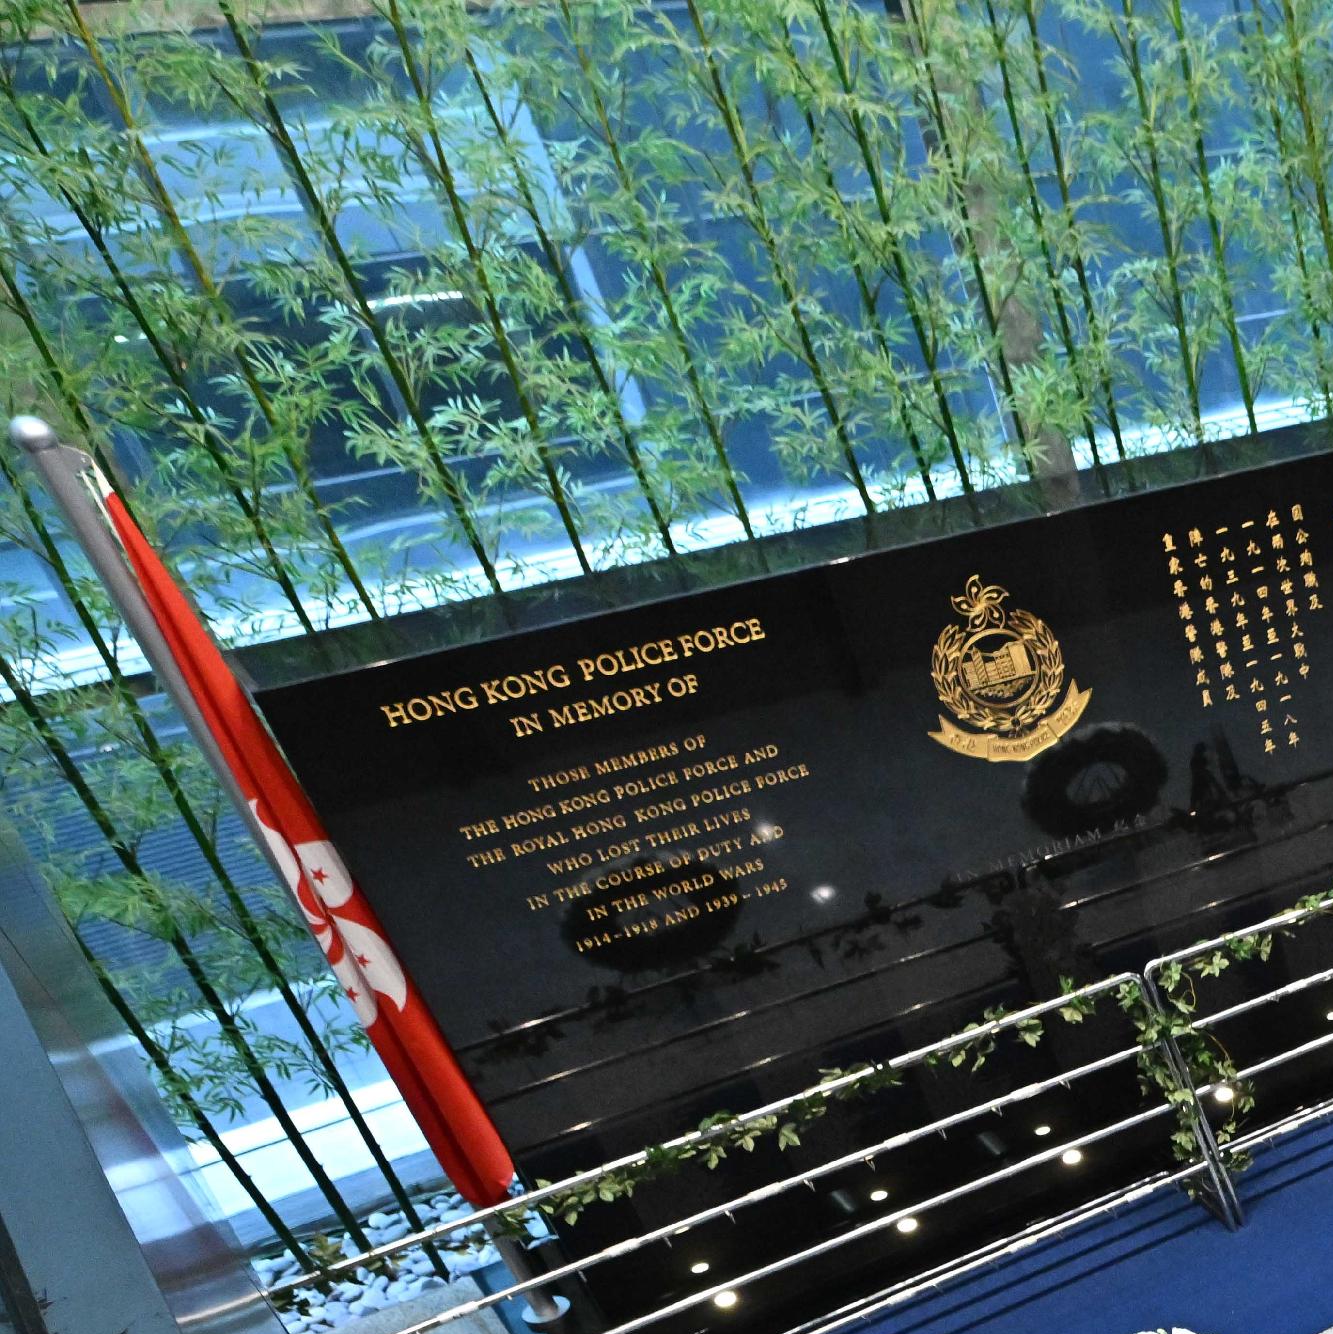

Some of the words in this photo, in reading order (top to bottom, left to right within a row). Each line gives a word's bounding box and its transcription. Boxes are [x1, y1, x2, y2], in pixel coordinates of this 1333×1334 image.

[381, 689, 479, 727] HONG
[481, 665, 570, 704] KONG
[578, 640, 677, 681] POLICE
[678, 618, 766, 656] FORCE
[1216, 527, 1275, 754] 一九三九年至一九四五年
[1242, 519, 1298, 748] 一九一四年至一九一八年
[511, 714, 543, 737] IN
[549, 683, 662, 728] MEMORY
[667, 675, 699, 698] OF
[460, 819, 499, 839] THE
[505, 807, 557, 828] HONG
[560, 791, 610, 814] KONG
[615, 772, 678, 798] POLICE
[684, 756, 739, 778] FORCE
[744, 746, 777, 764] AND
[529, 768, 589, 793] THOSE
[595, 742, 679, 775] MEMBERS
[684, 736, 705, 751] OF
[468, 849, 505, 868] THE
[512, 832, 567, 856] ROYAL
[571, 817, 625, 838] HONG
[635, 800, 685, 821] KONG
[691, 782, 751, 807] POLICE
[756, 764, 809, 788] FORCE
[548, 855, 592, 874] WHO
[601, 840, 640, 861] LOST
[647, 823, 700, 847] THEIR
[704, 810, 750, 832] LIVES
[527, 895, 549, 910] IN
[555, 882, 591, 903] THE
[597, 863, 664, 889] COURSE
[670, 854, 691, 869] OF
[698, 840, 741, 862] DUTY
[751, 828, 784, 845] AND
[588, 906, 609, 921] IN
[612, 894, 648, 912] THE
[652, 874, 714, 899] WORLD
[720, 861, 763, 879] WARS
[664, 907, 701, 925] AND
[706, 894, 739, 912] 1939
[756, 879, 787, 896] 1945
